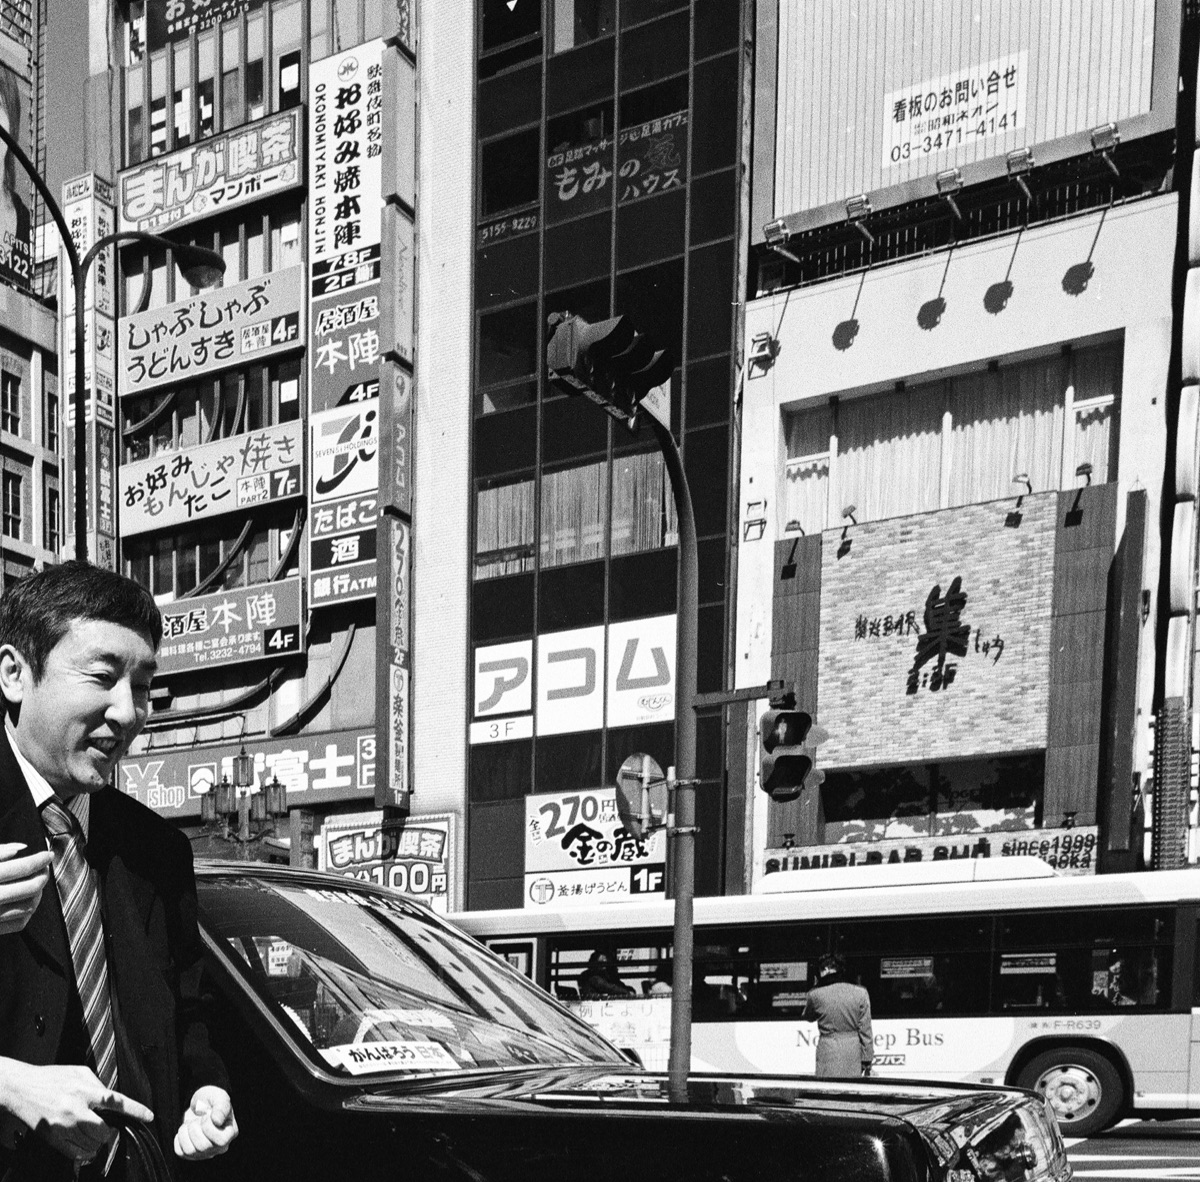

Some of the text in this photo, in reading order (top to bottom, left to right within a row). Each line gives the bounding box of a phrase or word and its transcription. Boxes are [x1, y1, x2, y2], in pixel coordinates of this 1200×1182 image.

[892, 64, 1017, 124] 看板のお問い合せ
[890, 110, 1018, 163] 03-3471-4141
[123, 114, 294, 221] まんが喫茶
[314, 83, 327, 255] OKONOMIYAKI HONJIN
[128, 279, 271, 350] しゃぶしゃぶ
[273, 316, 297, 343] 4F
[314, 296, 380, 336] 居酒屋
[127, 329, 235, 383] うどんすき
[314, 328, 380, 375] 本陣
[349, 383, 380, 402] 4F
[274, 470, 297, 497] 7F
[313, 499, 378, 535] たばこ
[330, 535, 361, 565] 酒
[313, 573, 377, 599] 銀行ATM
[268, 629, 294, 650] 4F
[478, 637, 672, 713] アコム
[489, 721, 516, 740] 3F
[332, 830, 443, 865] まんが喫茶
[560, 822, 650, 866] 金の蔵
[343, 862, 448, 894] 分100円
[557, 880, 628, 898] 釜揚げうどん
[633, 868, 664, 893] 1F
[905, 1027, 945, 1047] Bus
